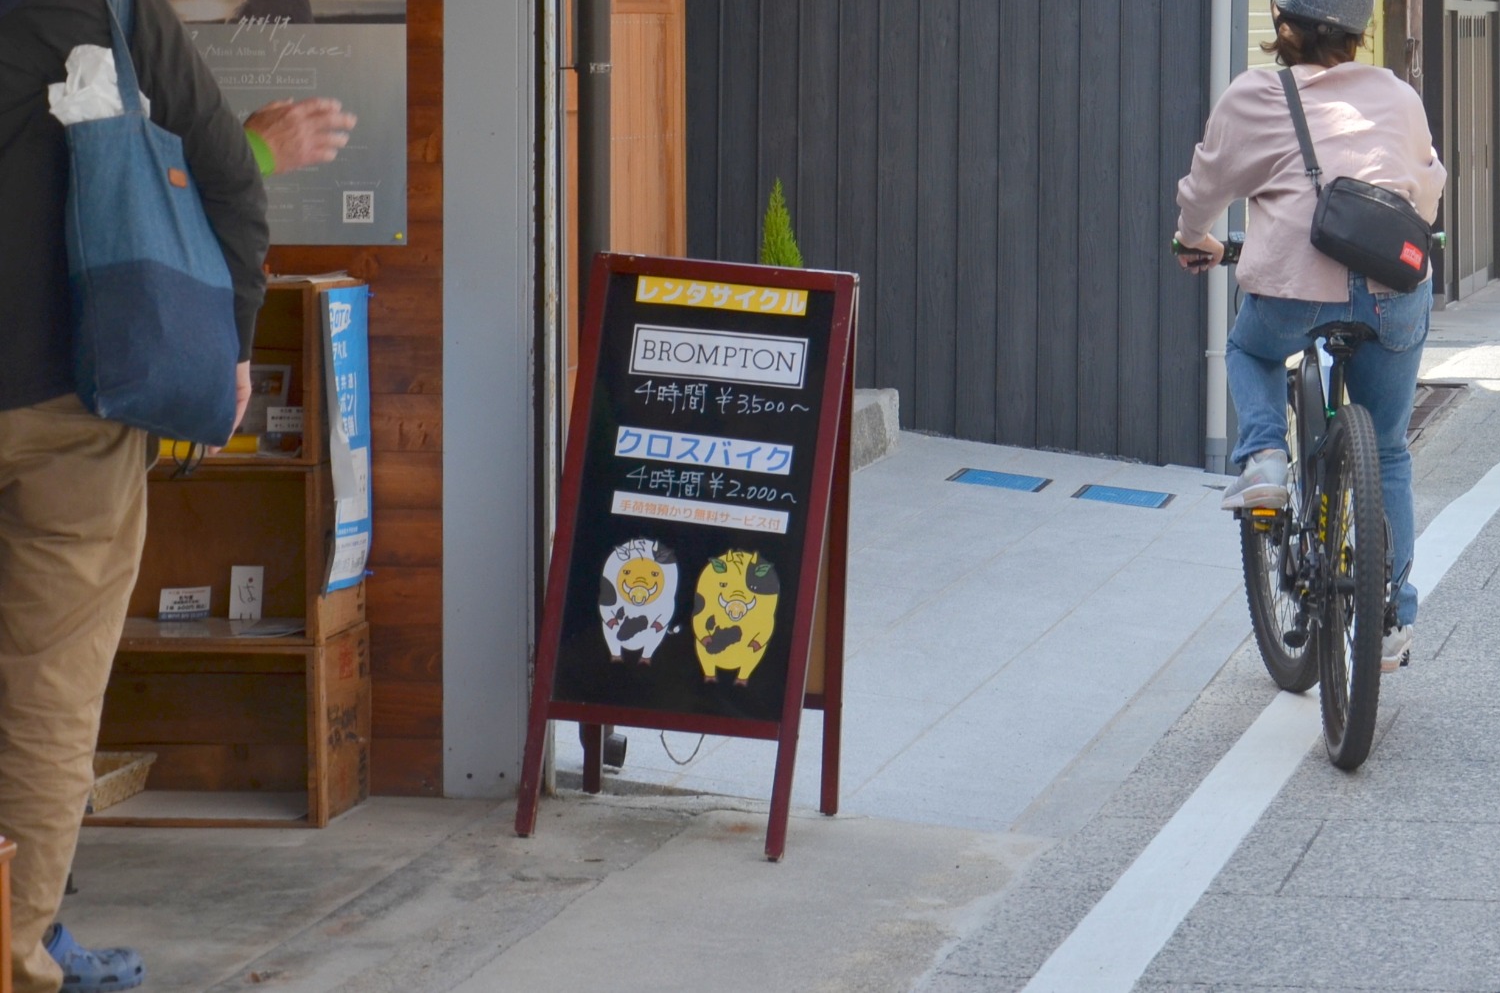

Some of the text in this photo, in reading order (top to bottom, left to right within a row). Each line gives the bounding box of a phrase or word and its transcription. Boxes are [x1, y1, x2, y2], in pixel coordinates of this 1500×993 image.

[638, 278, 806, 314] レンタサイクル
[641, 339, 796, 373] BROMPTON
[634, 380, 709, 414] 4時間
[618, 429, 791, 472] クロスバイク
[626, 465, 705, 498] 4時間
[619, 498, 782, 532] 手荷物預かり無料サービス付
